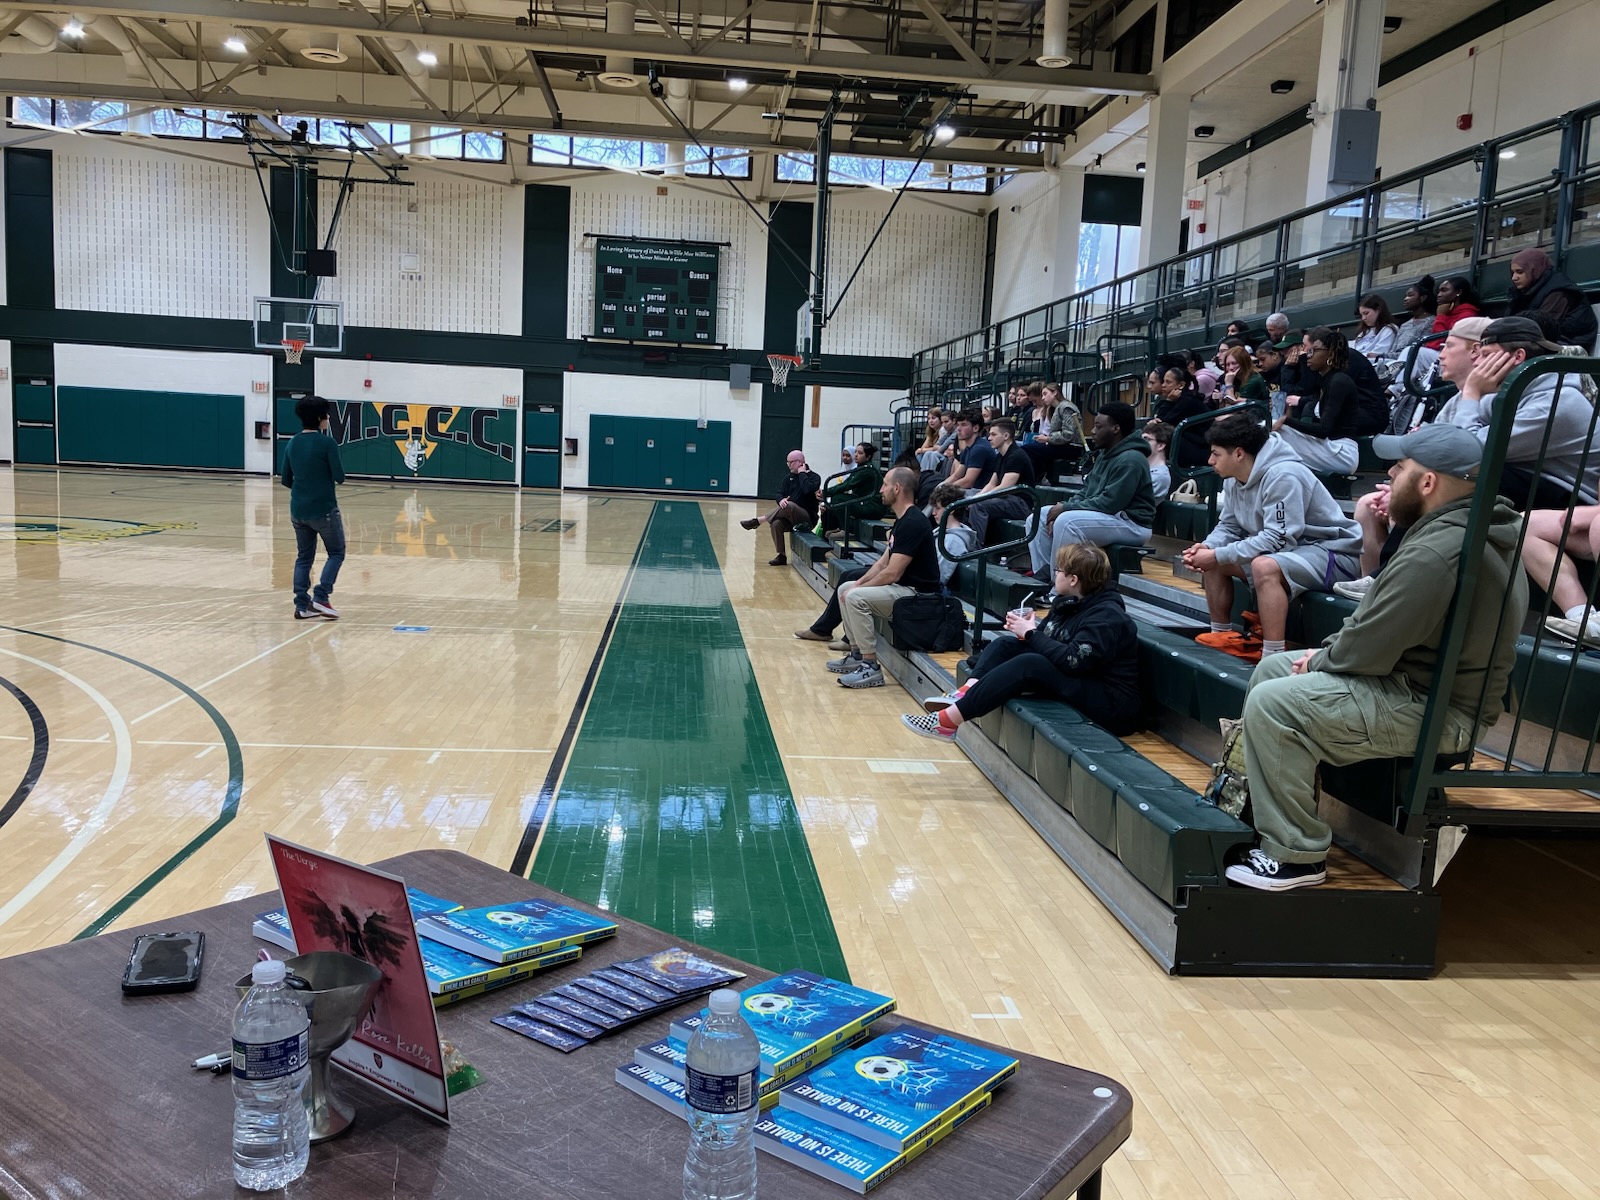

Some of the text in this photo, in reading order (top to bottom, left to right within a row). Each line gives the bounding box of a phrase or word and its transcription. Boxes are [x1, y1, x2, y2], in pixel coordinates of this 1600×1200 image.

[606, 266, 622, 274] Home
[689, 271, 709, 280] Guests
[602, 303, 616, 311] fouls
[647, 306, 666, 314] player
[326, 400, 514, 463] M.C.C.C.
[280, 847, 318, 871] The Verge
[431, 915, 466, 930] GOALIE!
[464, 926, 479, 937] NO
[477, 933, 489, 942] IS
[488, 938, 514, 950] THERE
[429, 963, 456, 979] THERE
[361, 1020, 433, 1069] Rose Kelly
[891, 1036, 921, 1049] Kelly
[760, 1041, 785, 1059] THER
[628, 1065, 670, 1086] GOALIE!
[662, 1081, 684, 1094] NO
[793, 1084, 912, 1134] THERE IS NO GOALIE!
[756, 1118, 873, 1174] THERE IS NO GOALIE!
